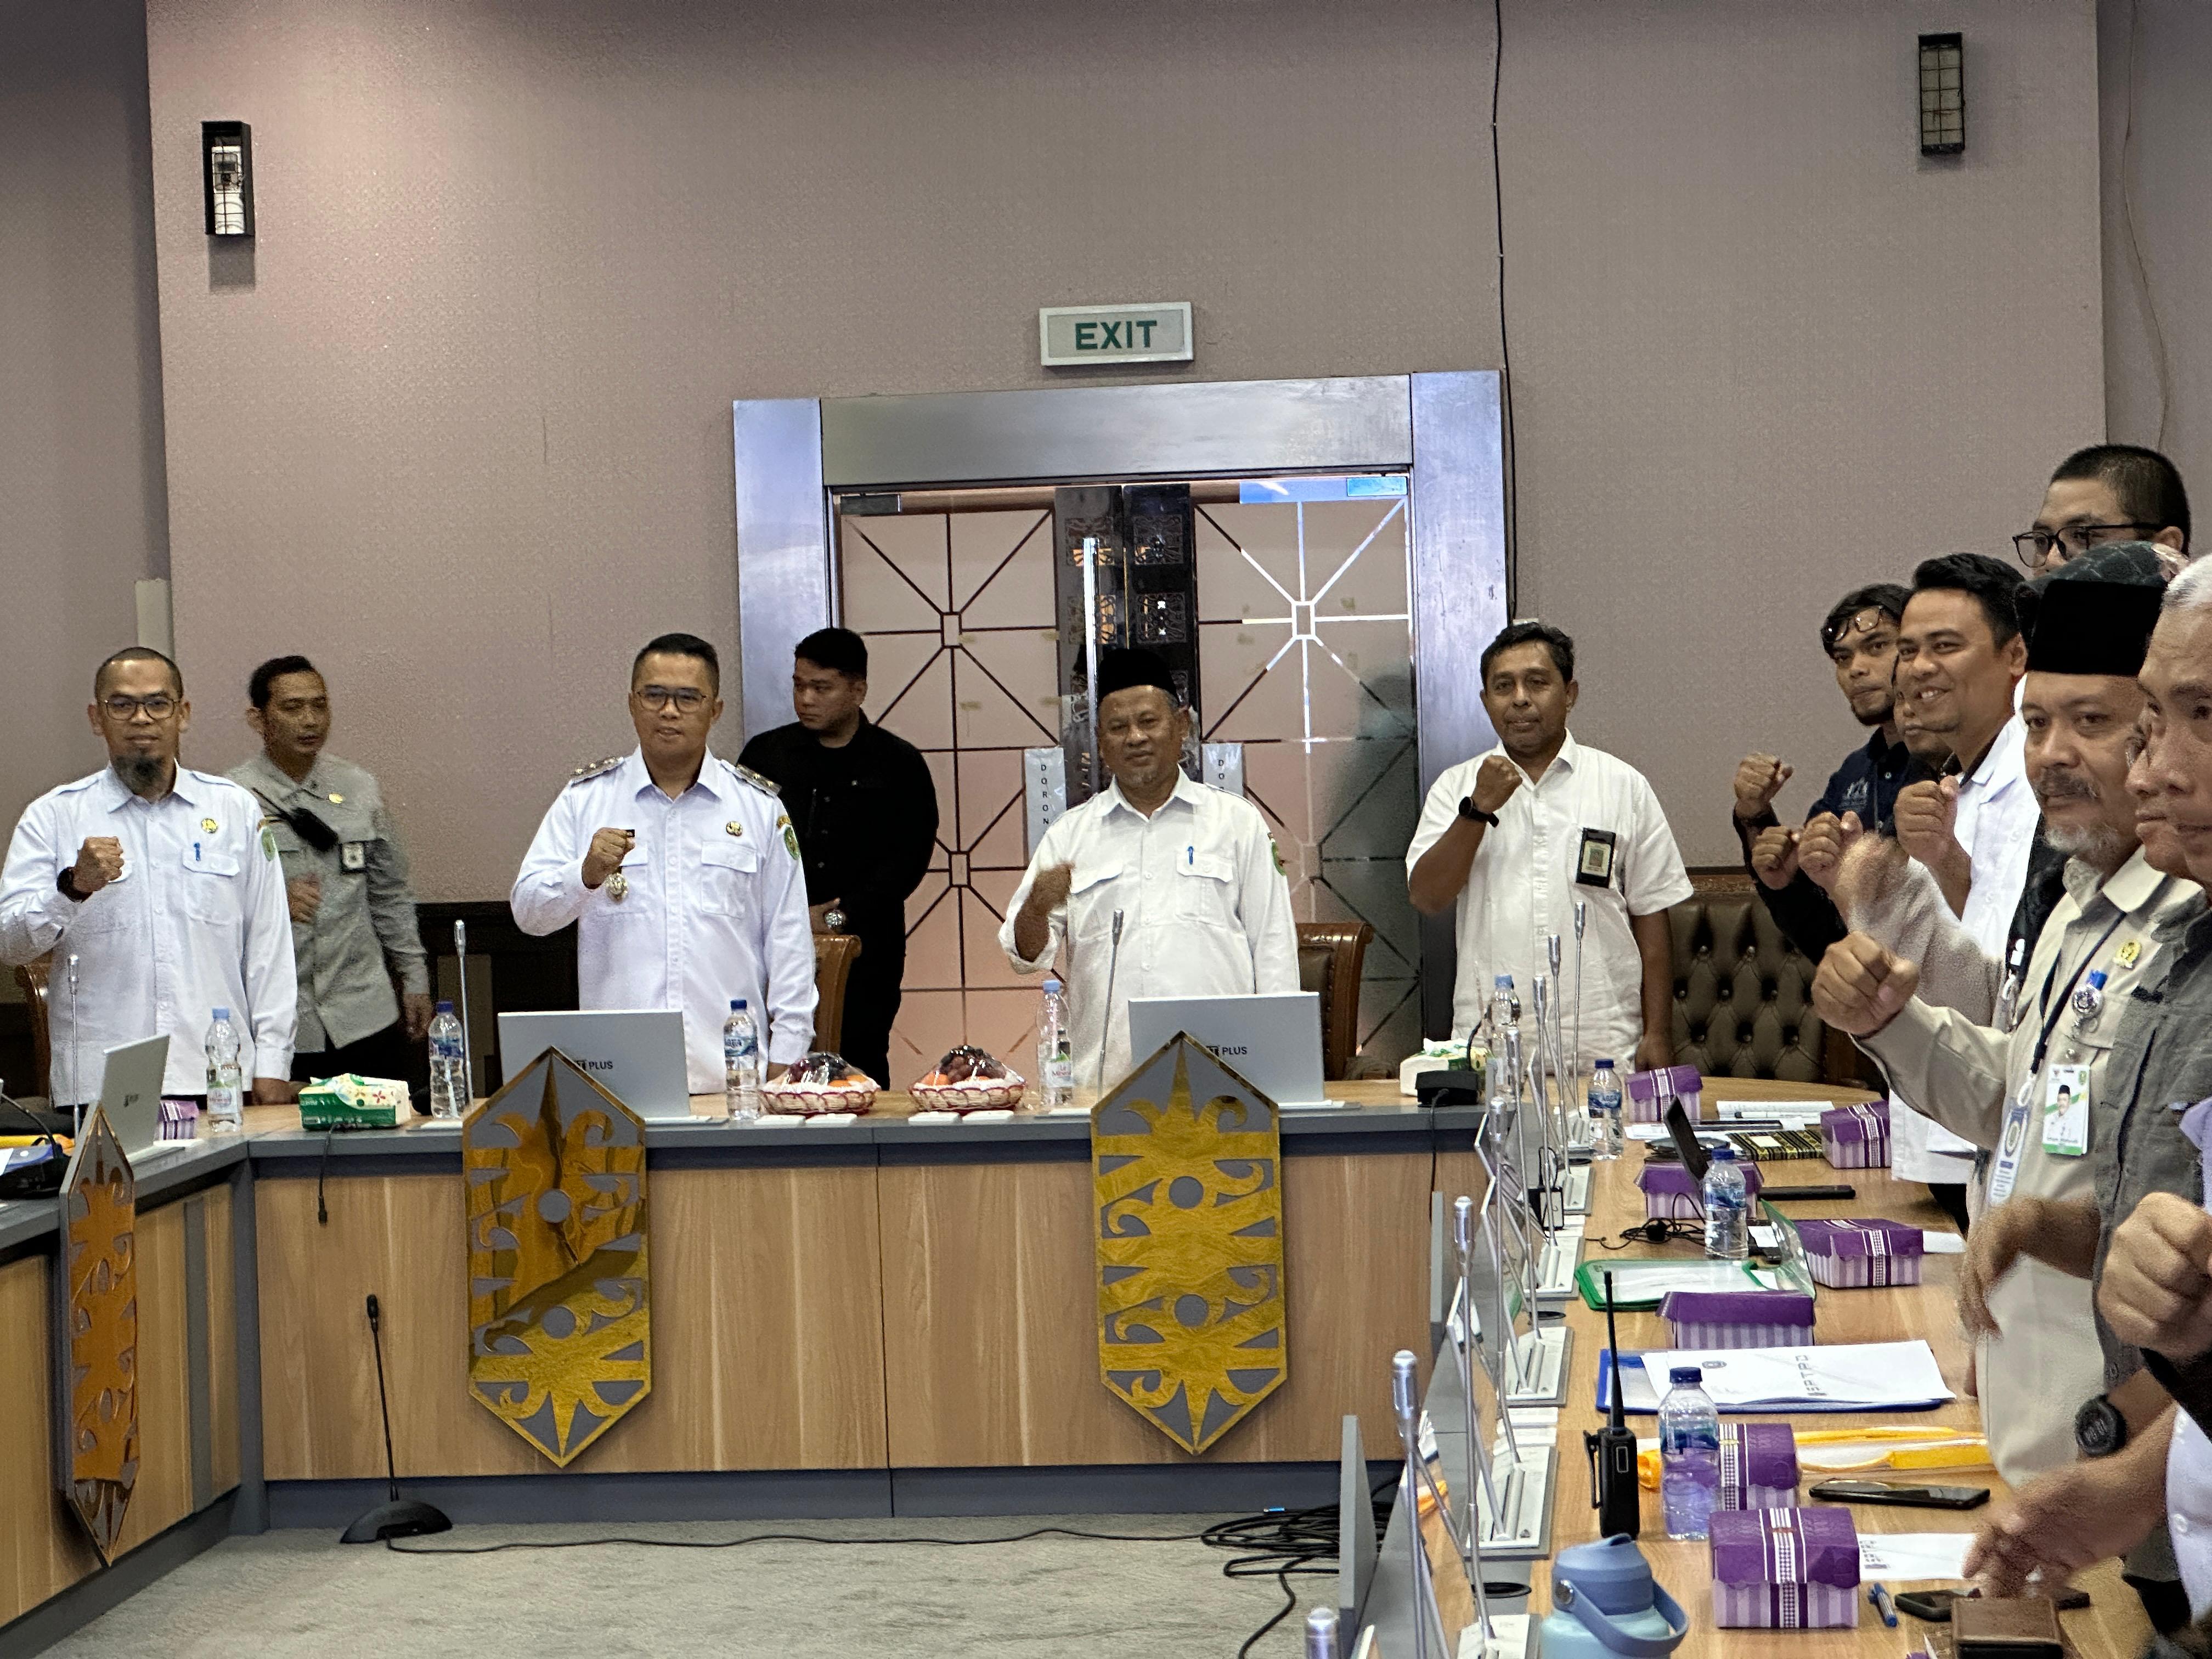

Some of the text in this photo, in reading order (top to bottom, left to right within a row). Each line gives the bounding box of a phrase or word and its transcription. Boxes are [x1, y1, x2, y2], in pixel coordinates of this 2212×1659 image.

[1075, 320, 1157, 350] EXIT
[1041, 764, 1049, 825] DORON
[1222, 1046, 1248, 1055] PLUS
[588, 1060, 613, 1070] PLUS
